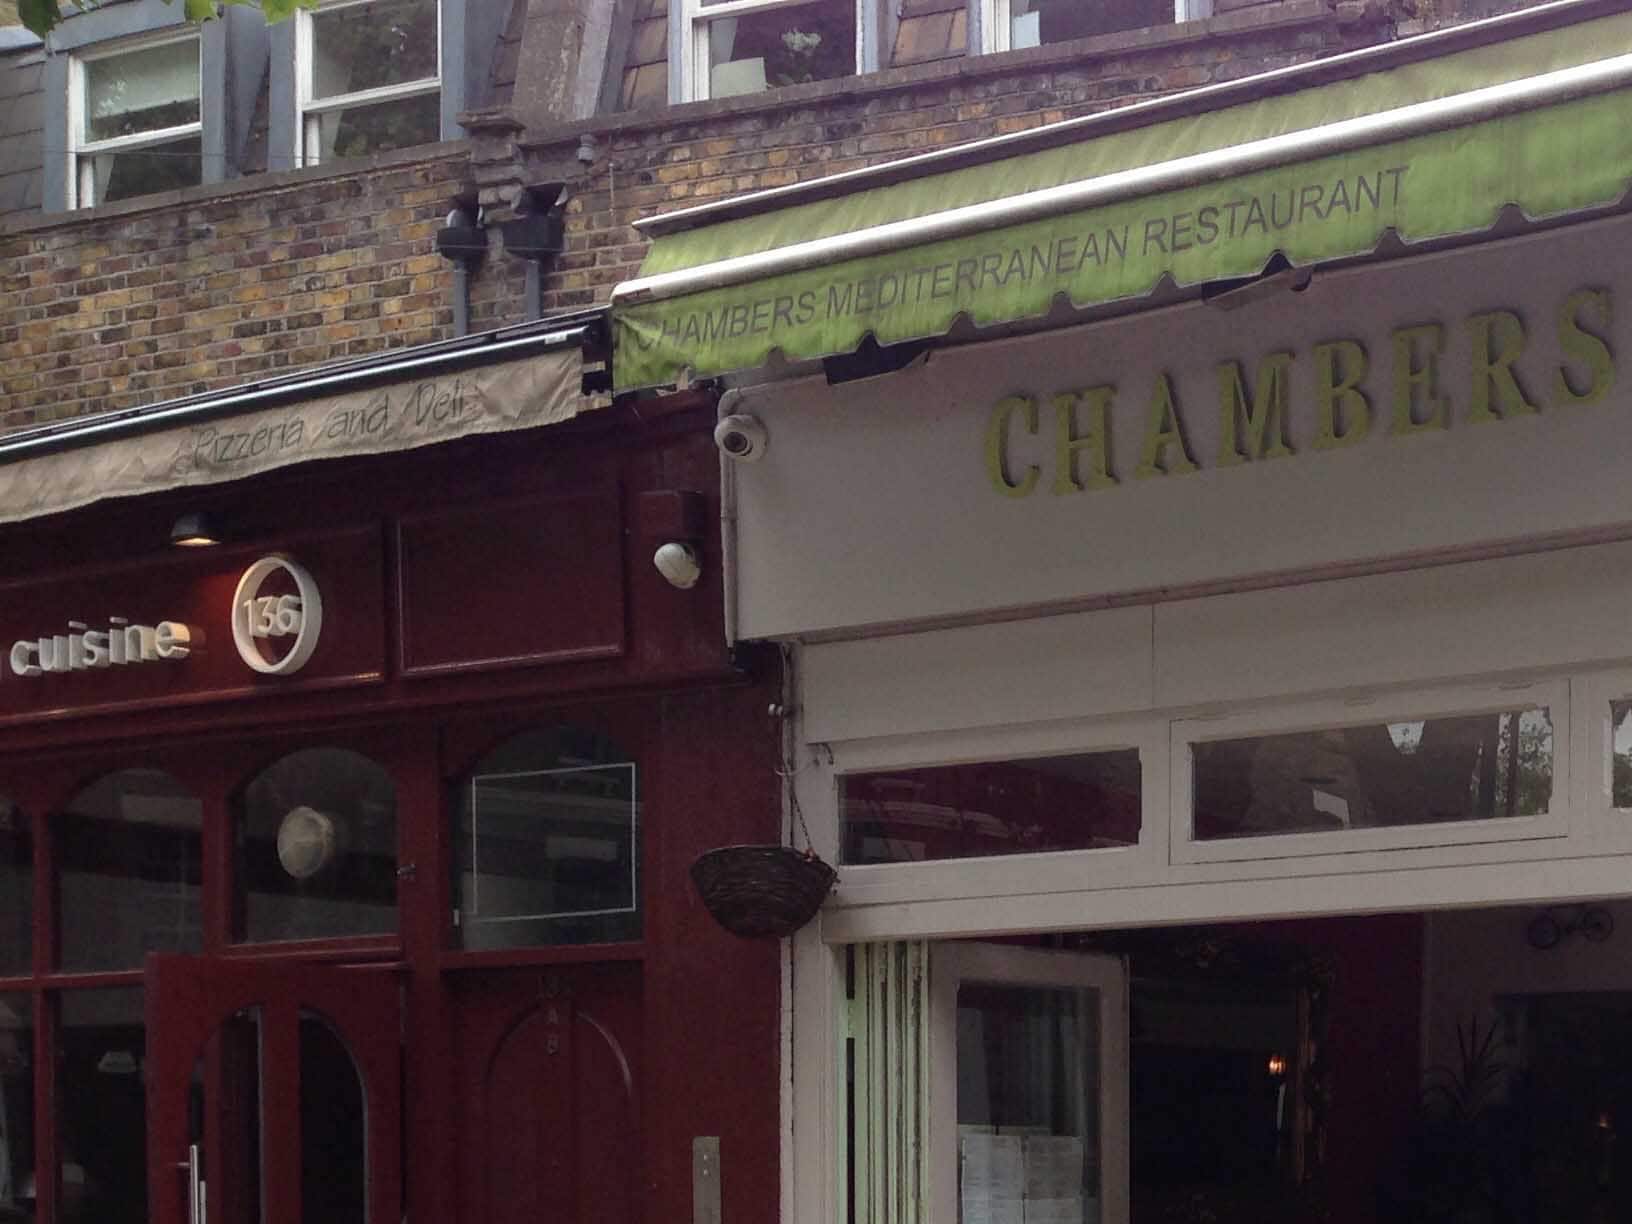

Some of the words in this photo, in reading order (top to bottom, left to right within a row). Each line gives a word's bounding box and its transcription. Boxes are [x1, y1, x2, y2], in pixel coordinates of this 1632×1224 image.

[636, 296, 816, 350] CHAMBERS
[826, 226, 1128, 320] MEDITERRANEAN
[1142, 166, 1409, 256] RESTAURANT
[190, 414, 305, 469] Pizzeria
[327, 394, 391, 438] and
[414, 379, 464, 425] Deli
[983, 289, 1616, 497] CHAMBERS
[10, 616, 191, 676] cuisine
[243, 595, 302, 640] 136
